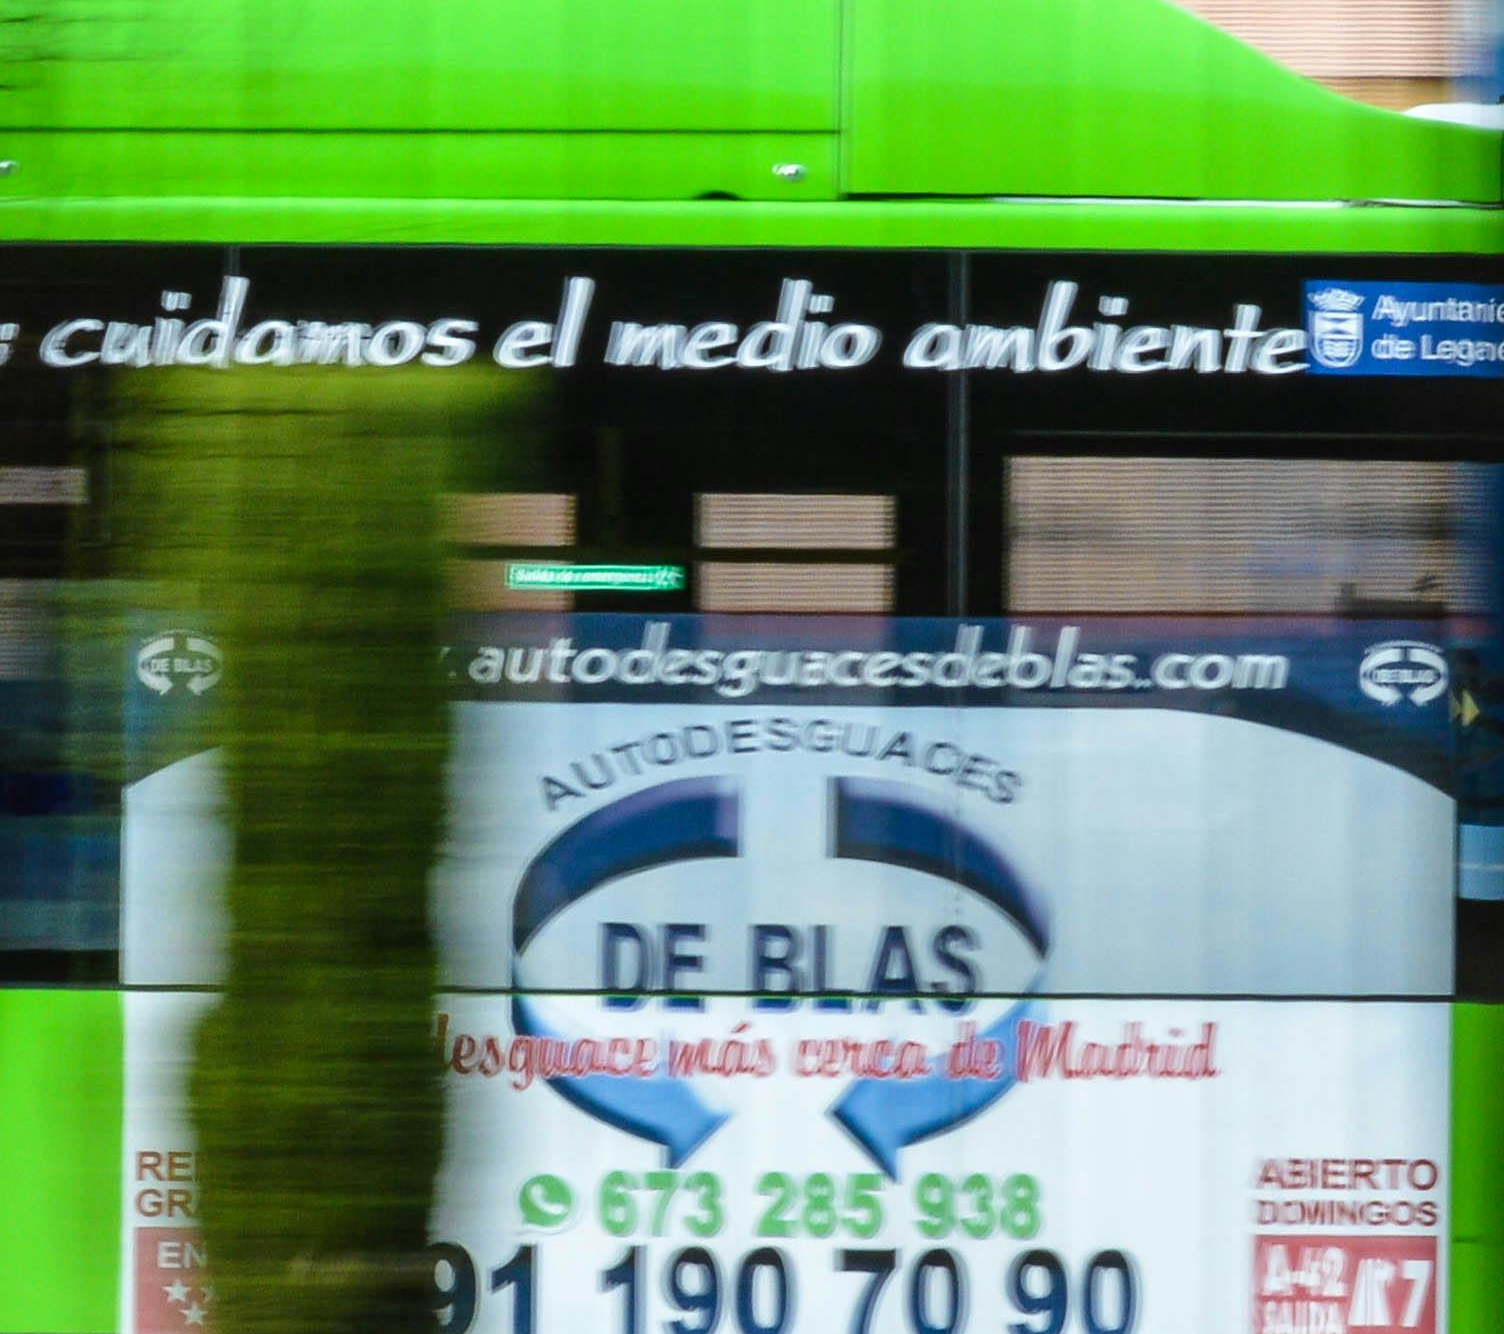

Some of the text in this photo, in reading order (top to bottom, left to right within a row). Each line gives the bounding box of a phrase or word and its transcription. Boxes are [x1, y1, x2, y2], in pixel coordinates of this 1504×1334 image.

[39, 276, 480, 368] cuidamos
[493, 277, 595, 368] el
[604, 278, 881, 371] medio
[902, 281, 1311, 374] ambiente
[1371, 333, 1416, 360] de
[538, 717, 1023, 810] AUTODESGUACES
[600, 921, 984, 1015] DE BLAS
[667, 1020, 777, 1078] más
[790, 1036, 934, 1080] cerca
[943, 1022, 1004, 1079] de
[1014, 1019, 1222, 1083] Madrid
[598, 1170, 1046, 1241] 673 285 938
[1256, 1158, 1439, 1190] ABIERTO
[1254, 1200, 1438, 1227] DOMINGOS
